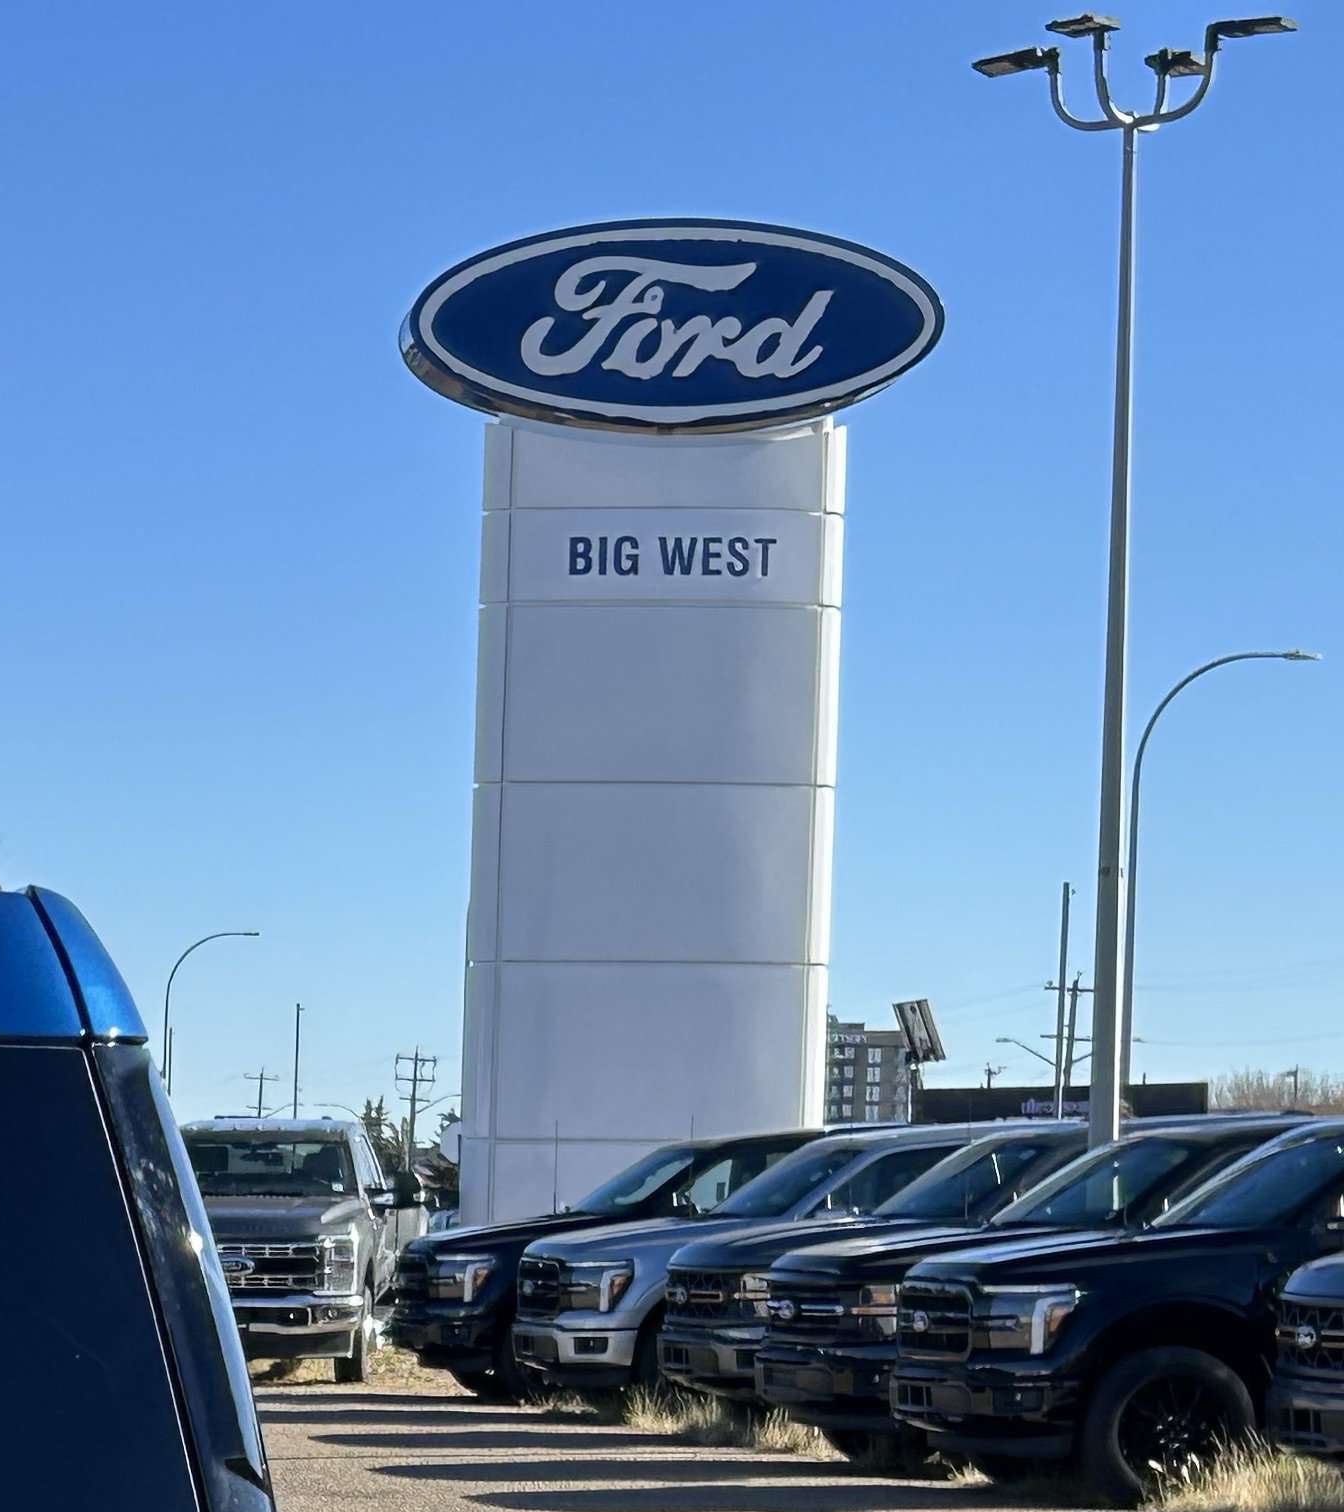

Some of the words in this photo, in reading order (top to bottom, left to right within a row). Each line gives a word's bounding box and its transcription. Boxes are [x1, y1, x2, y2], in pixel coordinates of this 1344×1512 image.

[521, 255, 834, 380] Ford
[568, 535, 640, 576] BIG
[658, 536, 777, 577] WEST
